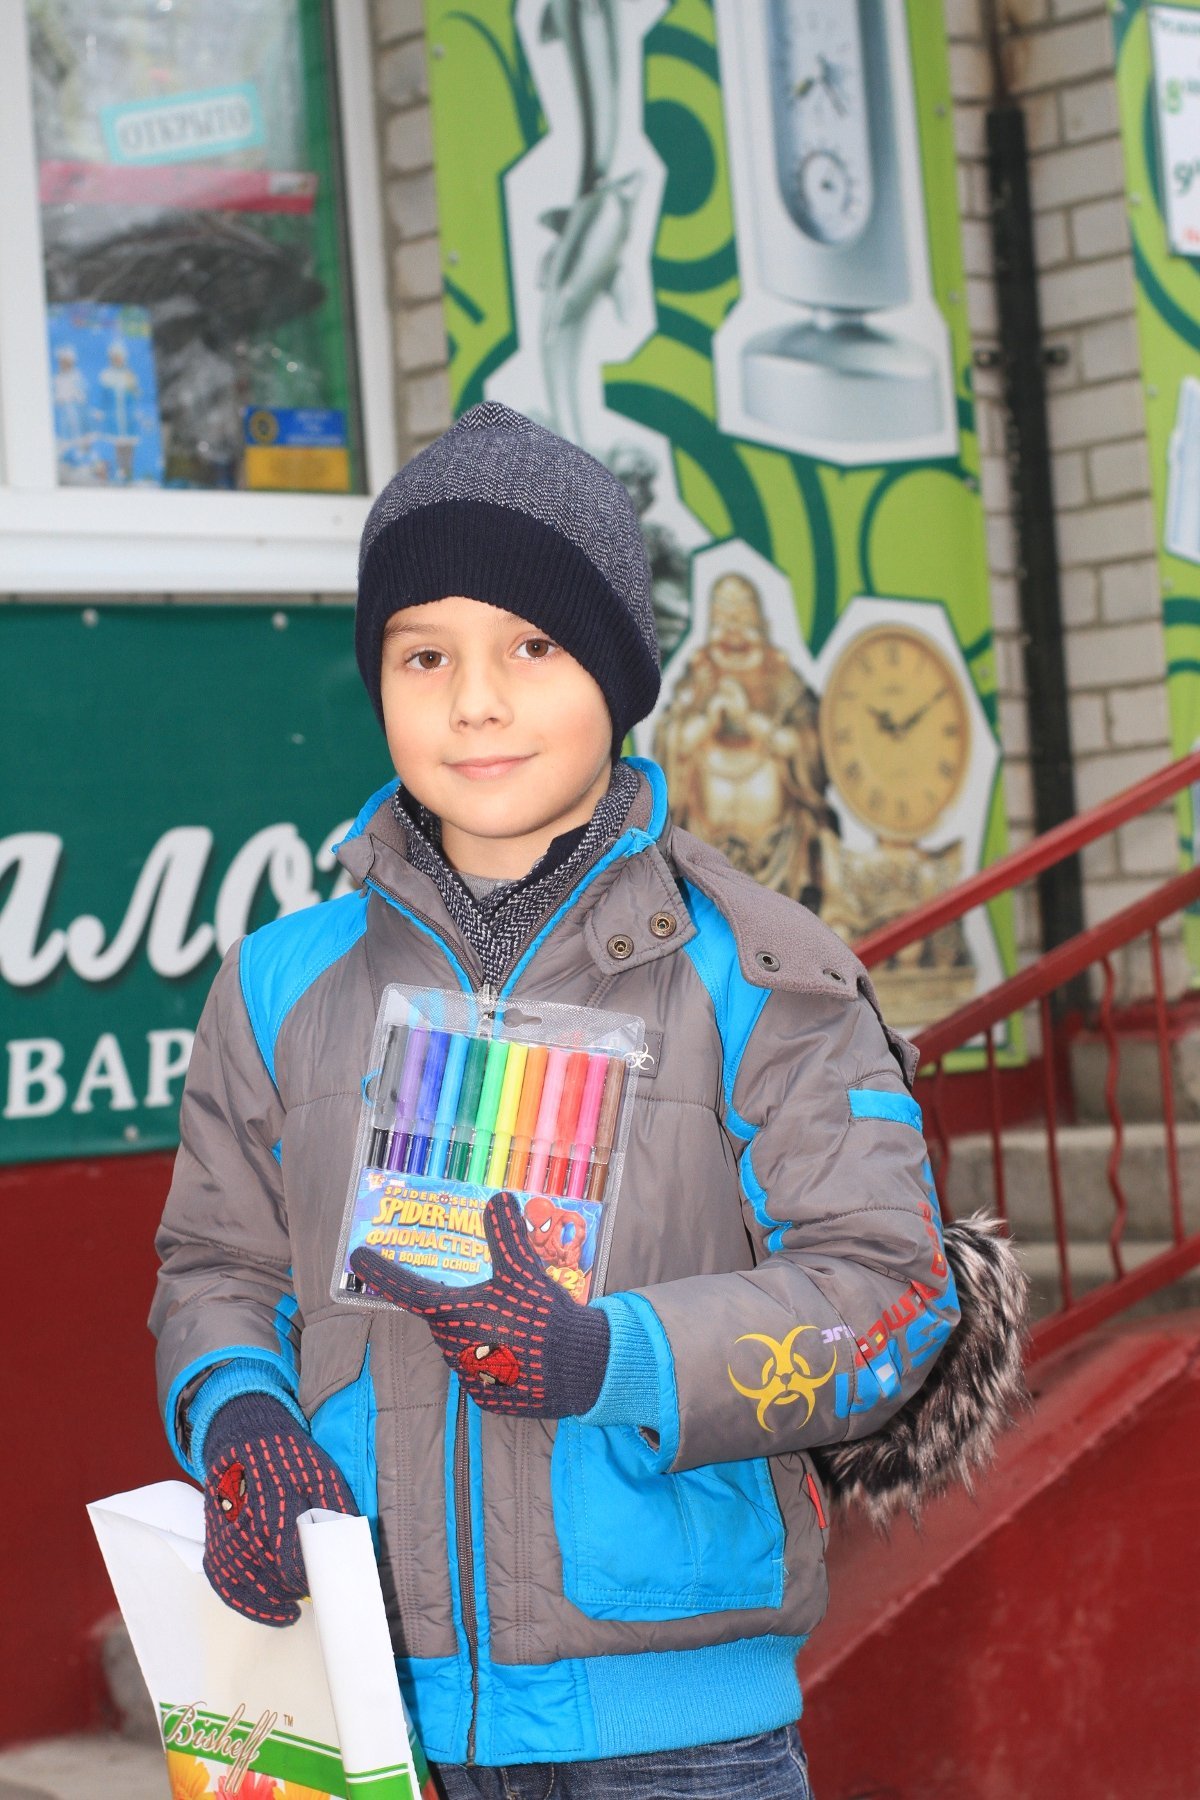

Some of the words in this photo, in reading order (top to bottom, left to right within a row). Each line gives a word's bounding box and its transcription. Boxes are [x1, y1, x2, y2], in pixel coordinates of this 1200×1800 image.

[384, 1185, 438, 1203] SPIDER
[381, 1248, 395, 1261] на
[442, 1257, 480, 1273] основі
